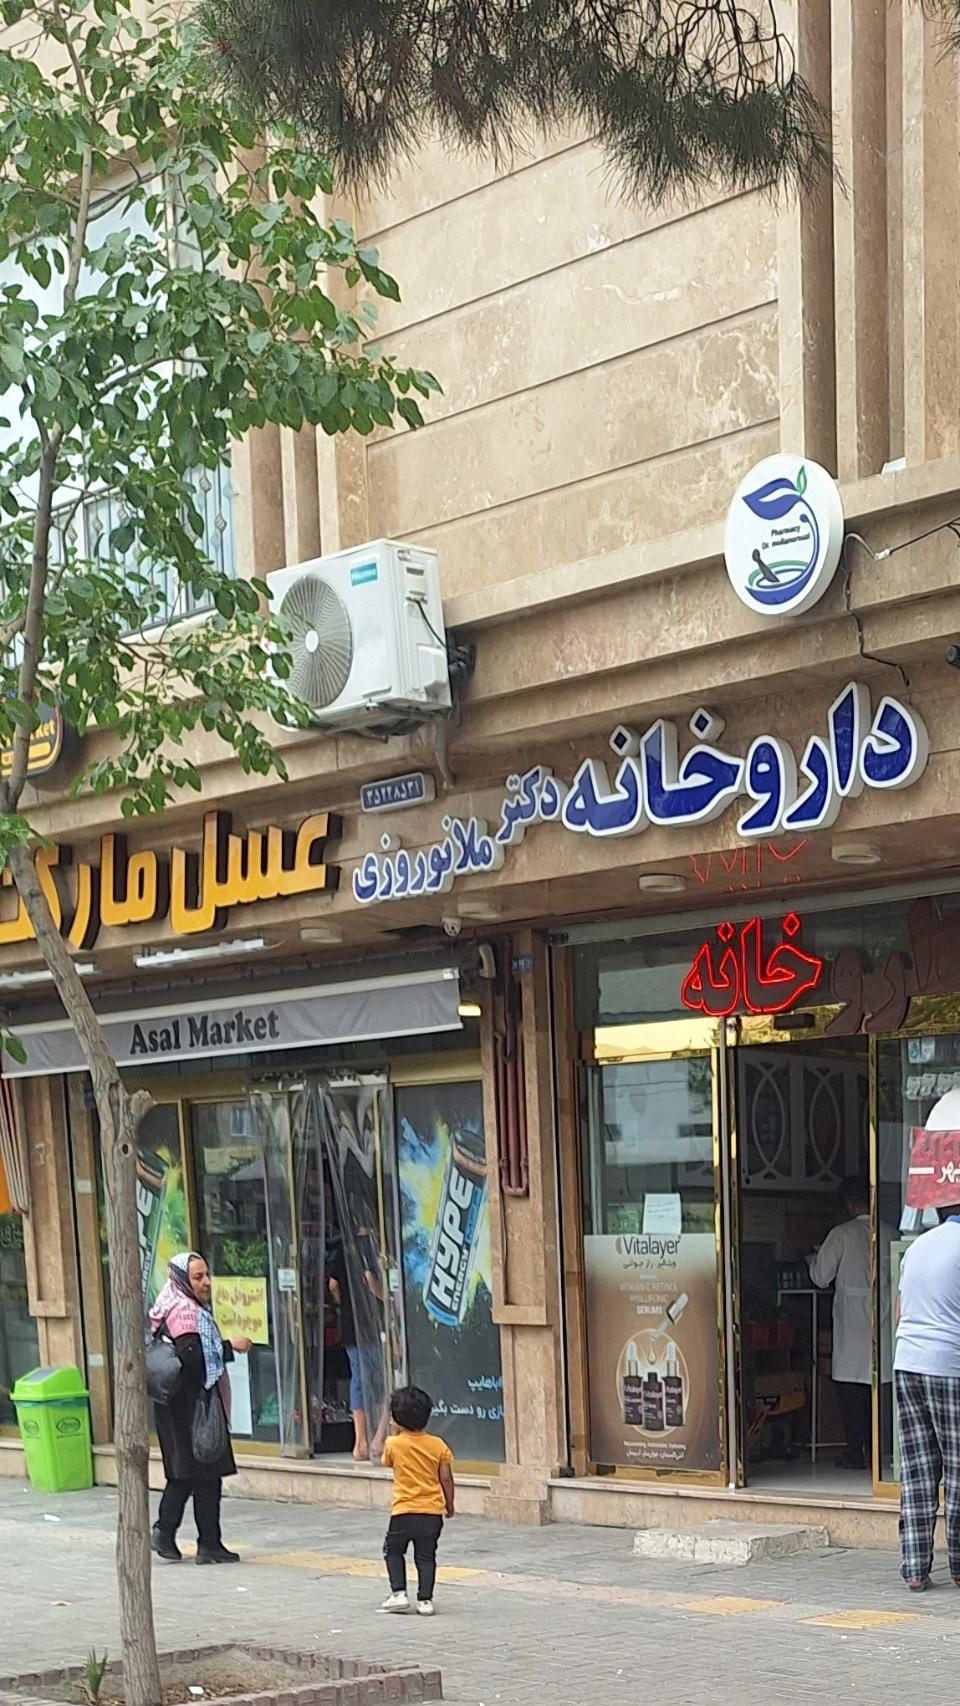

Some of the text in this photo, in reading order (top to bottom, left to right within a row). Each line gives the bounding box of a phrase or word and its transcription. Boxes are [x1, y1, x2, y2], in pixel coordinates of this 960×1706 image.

[562, 682, 920, 836] داروخانه
[497, 765, 561, 844] دکتر
[0, 810, 331, 949] عسل مارک
[129, 1010, 280, 1055] Asal Market
[430, 1166, 475, 1309] HYPE
[622, 1235, 680, 1259] Vitalayer
[451, 1249, 469, 1312] ENERGY
[450, 1403, 473, 1415] دست
